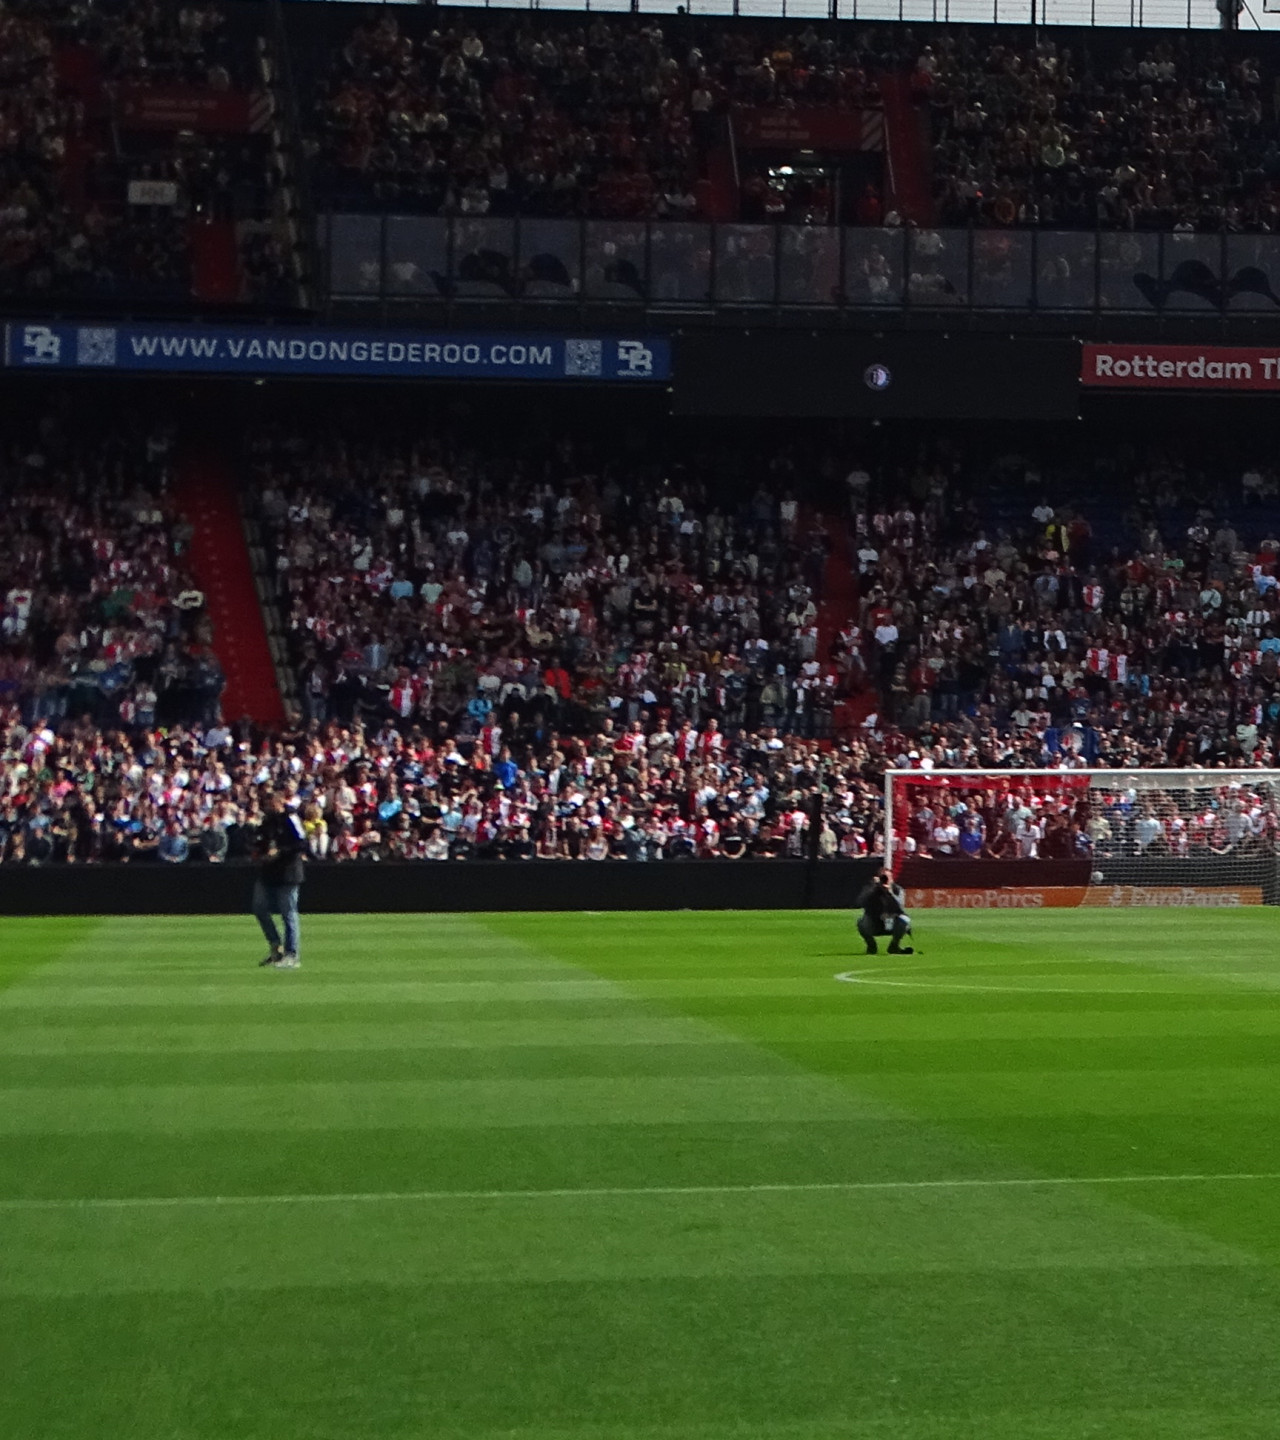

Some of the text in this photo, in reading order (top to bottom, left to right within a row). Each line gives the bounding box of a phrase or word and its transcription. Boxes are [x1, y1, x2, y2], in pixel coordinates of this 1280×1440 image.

[131, 336, 552, 365] WWW.VANDONGEDEROO.COM
[1095, 354, 1252, 379] Rotterdam
[932, 889, 1044, 908] EuroParcs
